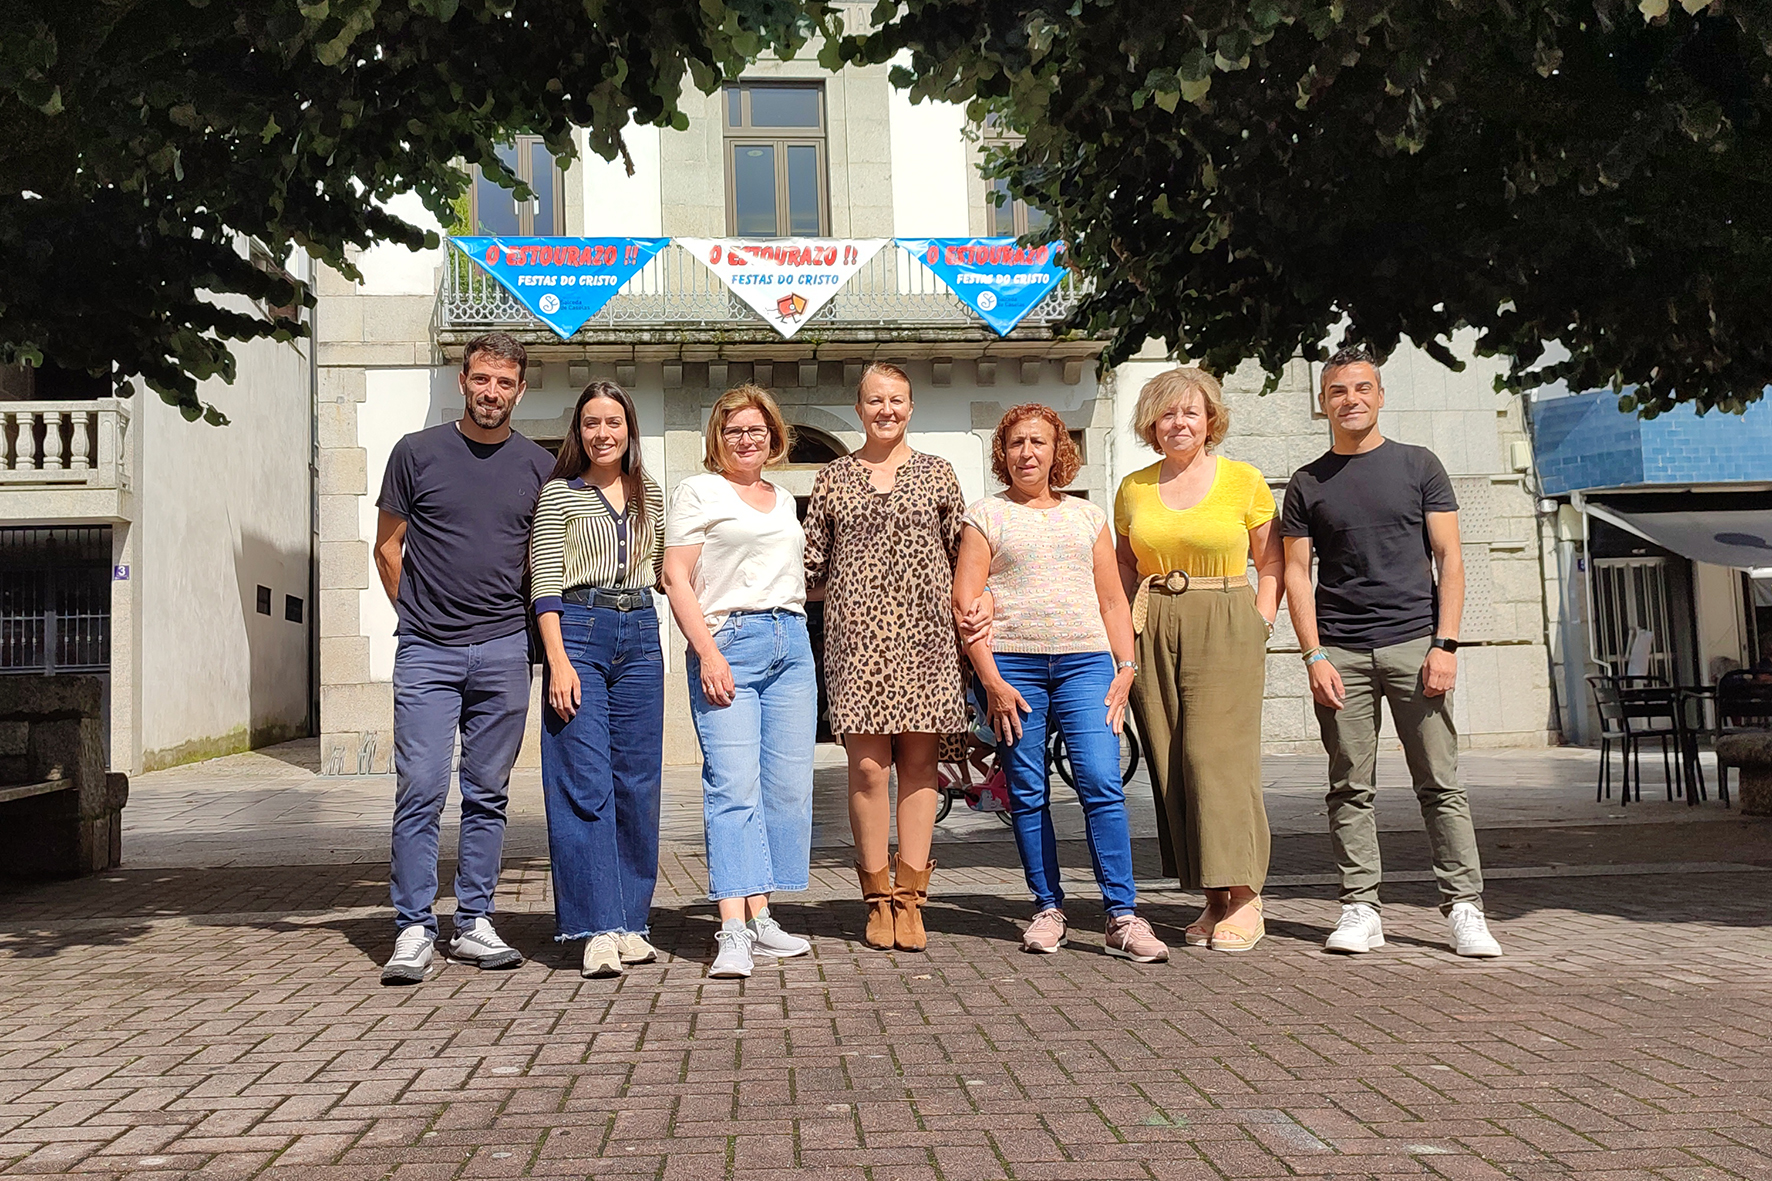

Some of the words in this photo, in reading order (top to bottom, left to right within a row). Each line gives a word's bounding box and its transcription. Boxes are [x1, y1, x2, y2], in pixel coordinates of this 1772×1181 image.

[485, 245, 500, 266] O
[506, 245, 617, 267] ESTOURAZO
[623, 245, 639, 266] !!
[709, 245, 722, 264] O
[843, 245, 858, 265] !!
[926, 245, 940, 265] O
[518, 275, 557, 286] FESTAS
[560, 275, 576, 286] DO
[579, 275, 618, 287] CRISTO
[731, 274, 773, 285] FESTAS
[777, 274, 793, 285] DO
[798, 274, 839, 286] CRISTO
[956, 274, 994, 285] FESTAS
[995, 274, 1011, 284] DO
[1013, 273, 1050, 285] CRISTO
[118, 566, 126, 576] 3
